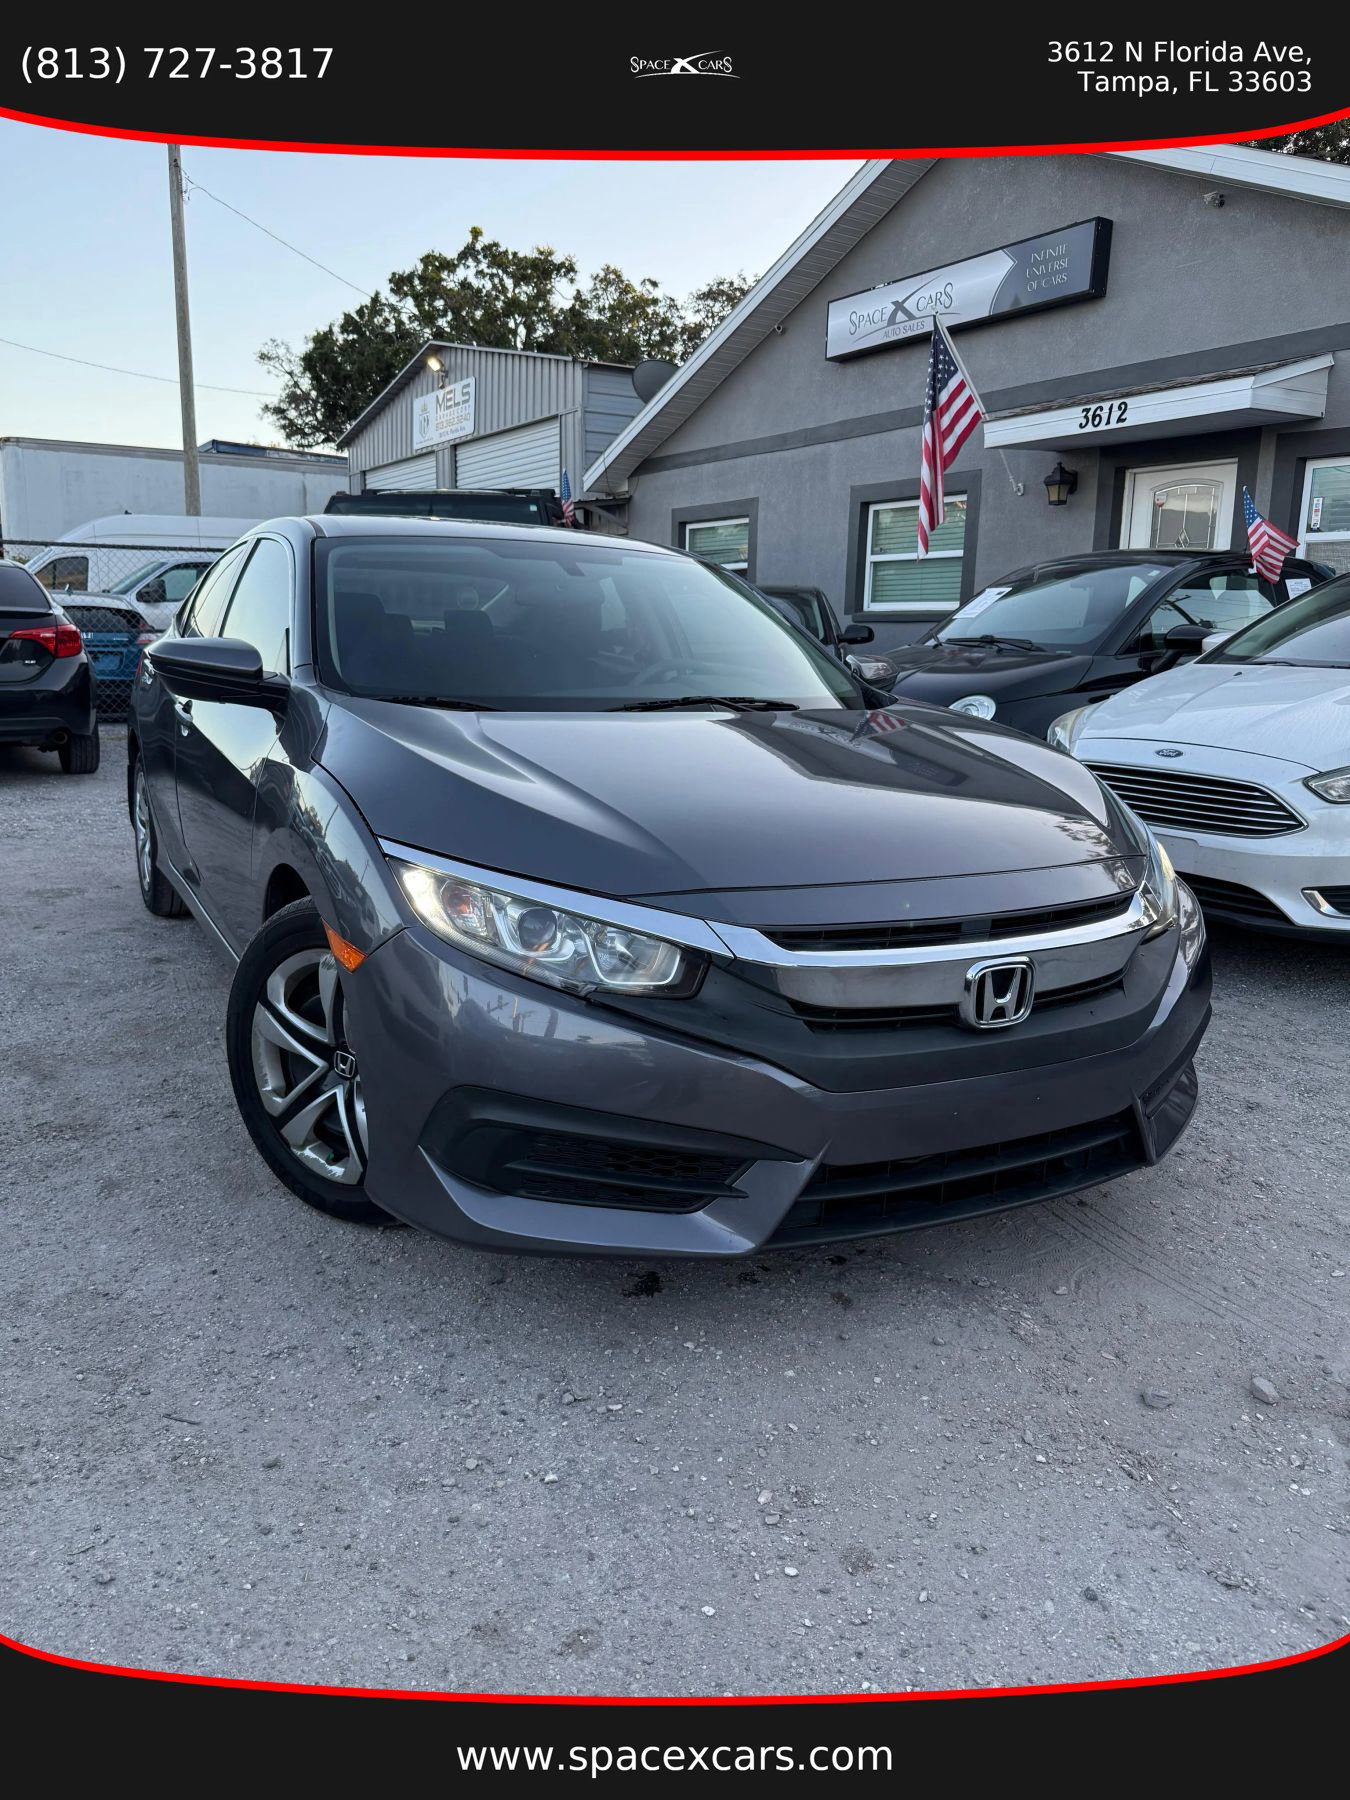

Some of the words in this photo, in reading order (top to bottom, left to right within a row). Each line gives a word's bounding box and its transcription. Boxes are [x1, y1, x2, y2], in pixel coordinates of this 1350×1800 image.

[882, 327, 901, 339] AUTO
[902, 320, 925, 335] SALES
[435, 382, 471, 415] MELS
[1078, 401, 1129, 429] 3612
